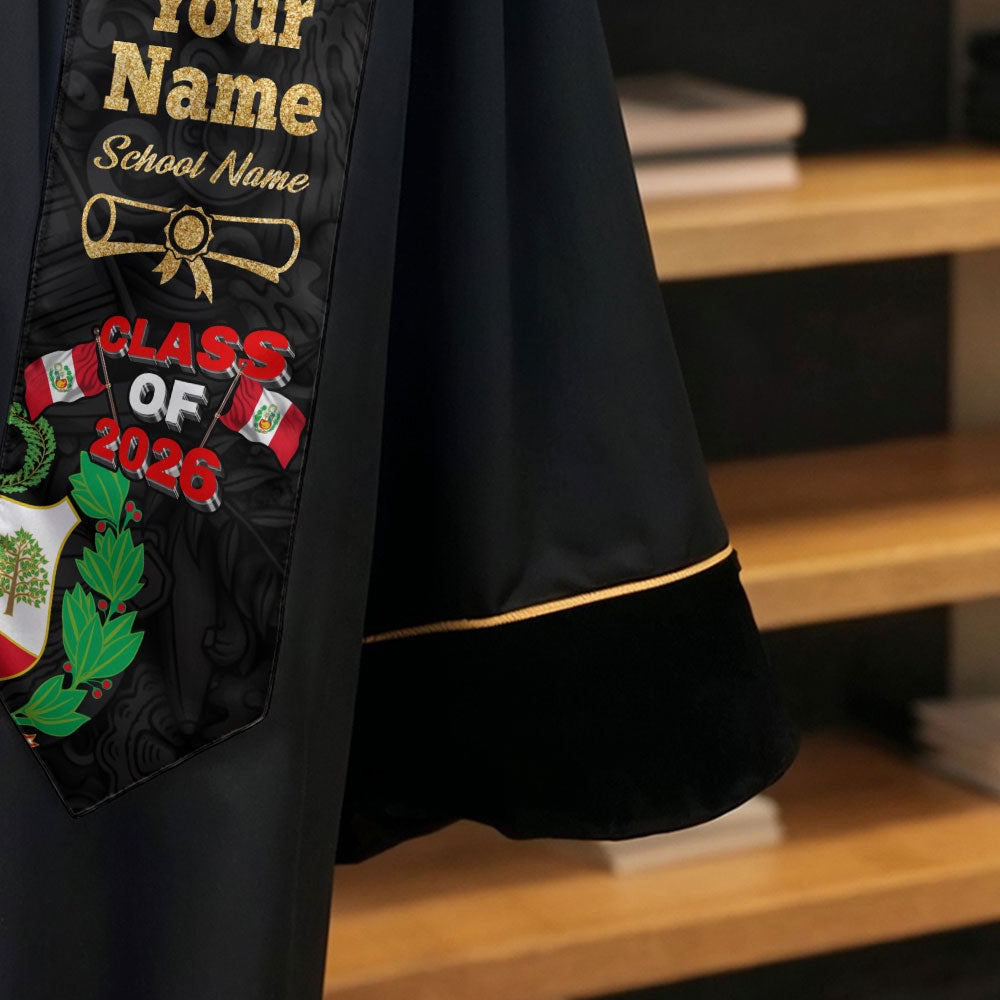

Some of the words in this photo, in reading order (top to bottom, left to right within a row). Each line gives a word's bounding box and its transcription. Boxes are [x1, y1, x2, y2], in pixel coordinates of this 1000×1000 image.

[103, 40, 323, 136] Name
[93, 134, 209, 179] School
[209, 149, 310, 194] Name
[100, 315, 295, 388] CLASS
[129, 372, 209, 433] OF
[89, 417, 223, 513] 2026
